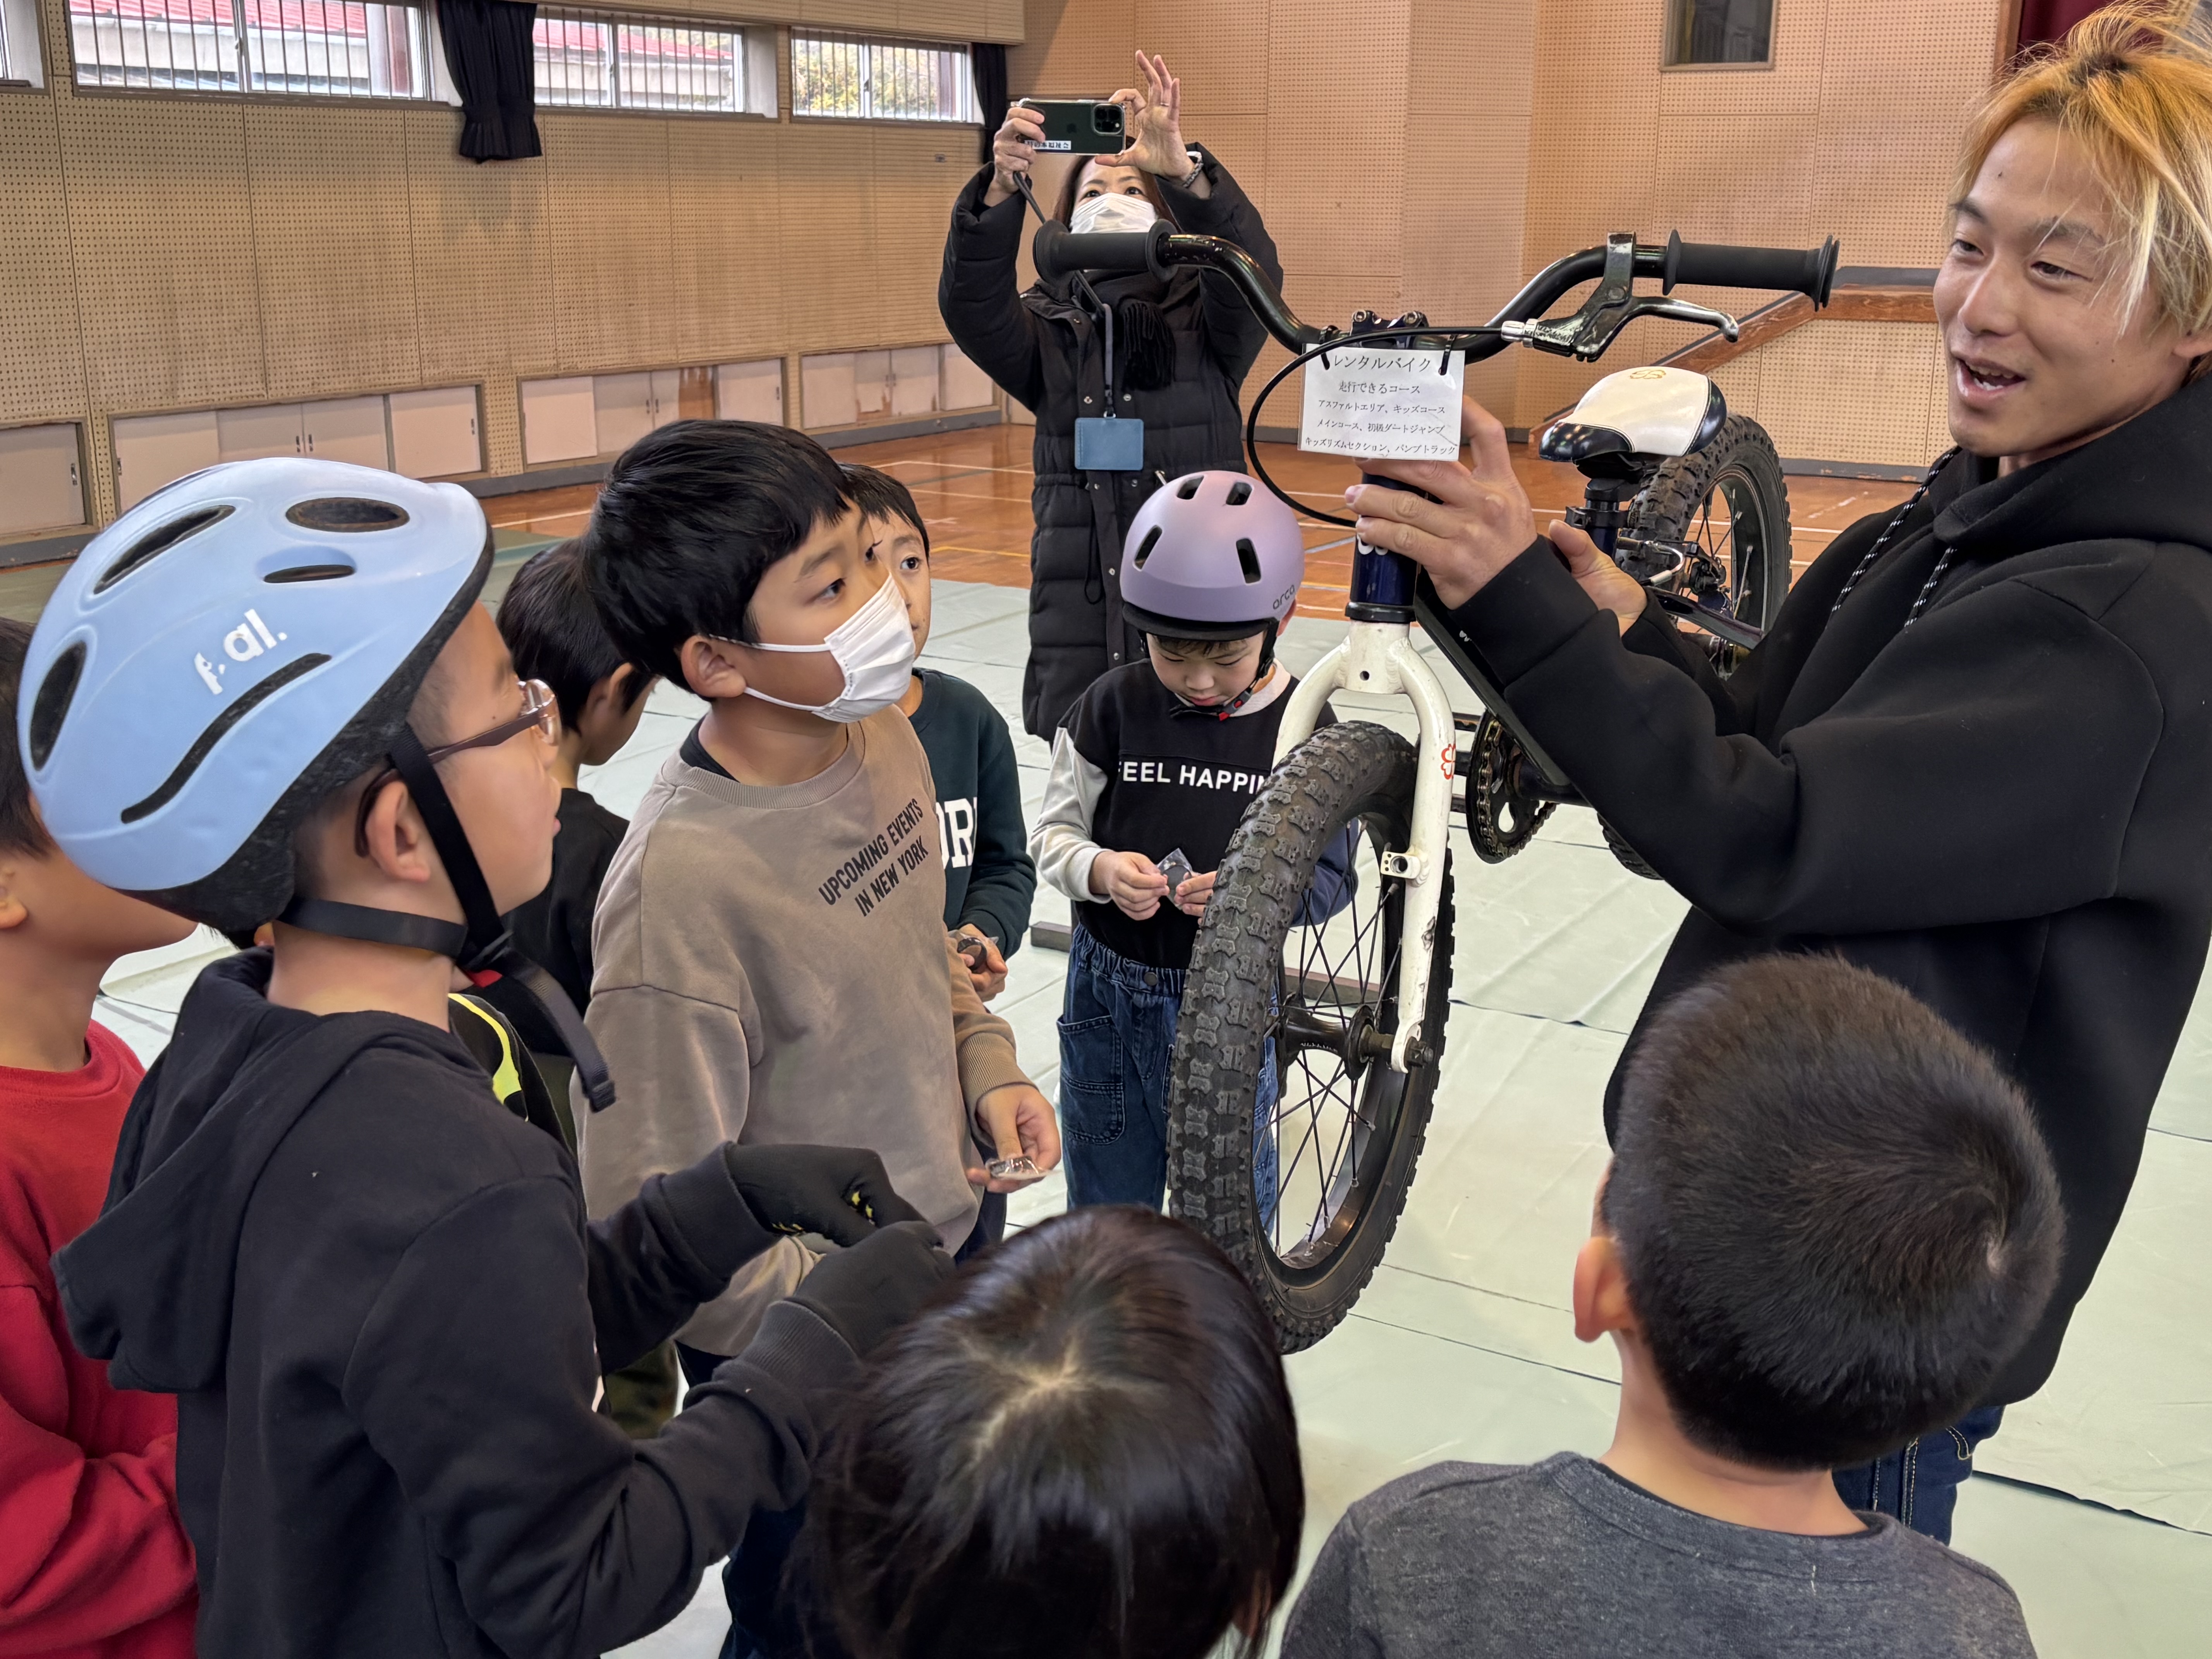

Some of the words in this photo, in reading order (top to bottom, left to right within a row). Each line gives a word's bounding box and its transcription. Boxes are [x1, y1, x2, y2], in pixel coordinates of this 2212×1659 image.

[1339, 381, 1420, 394] 走行できるコース
[1273, 584, 1295, 610] orca
[1118, 761, 1171, 783] EEL
[818, 834, 889, 906] UPCOMING
[886, 798, 924, 847] EVENTS
[854, 889, 874, 917] IN
[870, 863, 900, 902] NEW
[897, 835, 929, 876] YORK
